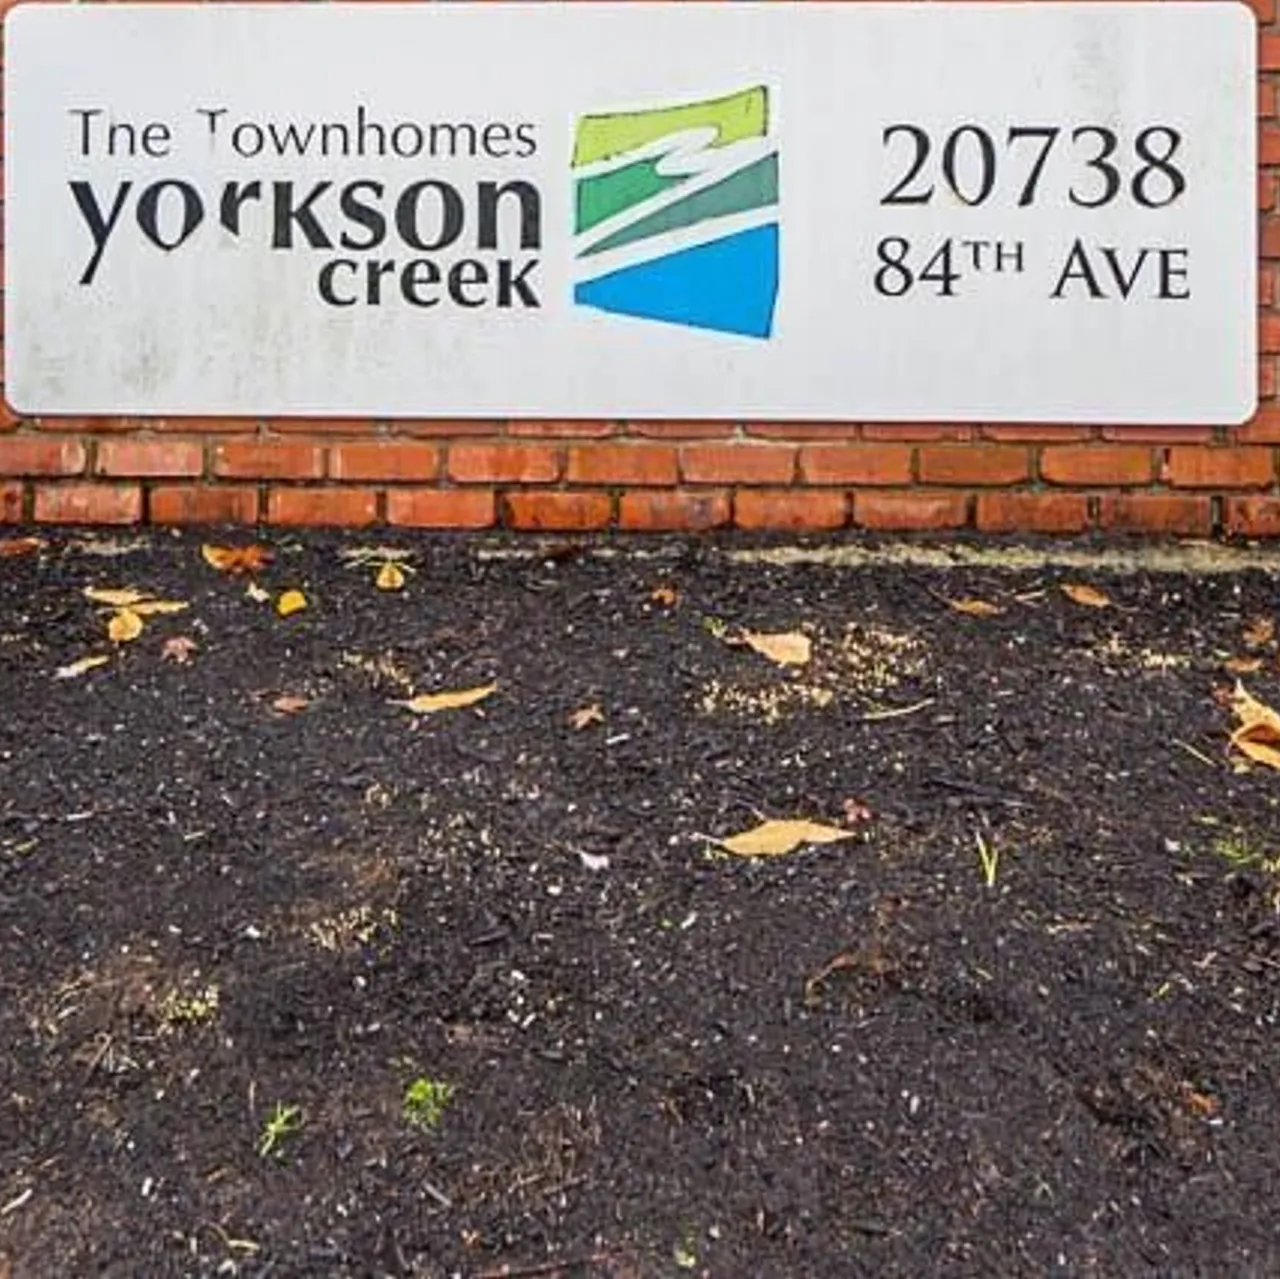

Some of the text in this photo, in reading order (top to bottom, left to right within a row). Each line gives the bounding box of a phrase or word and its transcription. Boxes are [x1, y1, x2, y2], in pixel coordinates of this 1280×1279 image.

[196, 105, 538, 158] Townhomes
[880, 124, 1186, 208] 20738
[68, 179, 542, 285] yorkson
[318, 258, 541, 308] creek
[874, 236, 1191, 300] 84TH AVE
